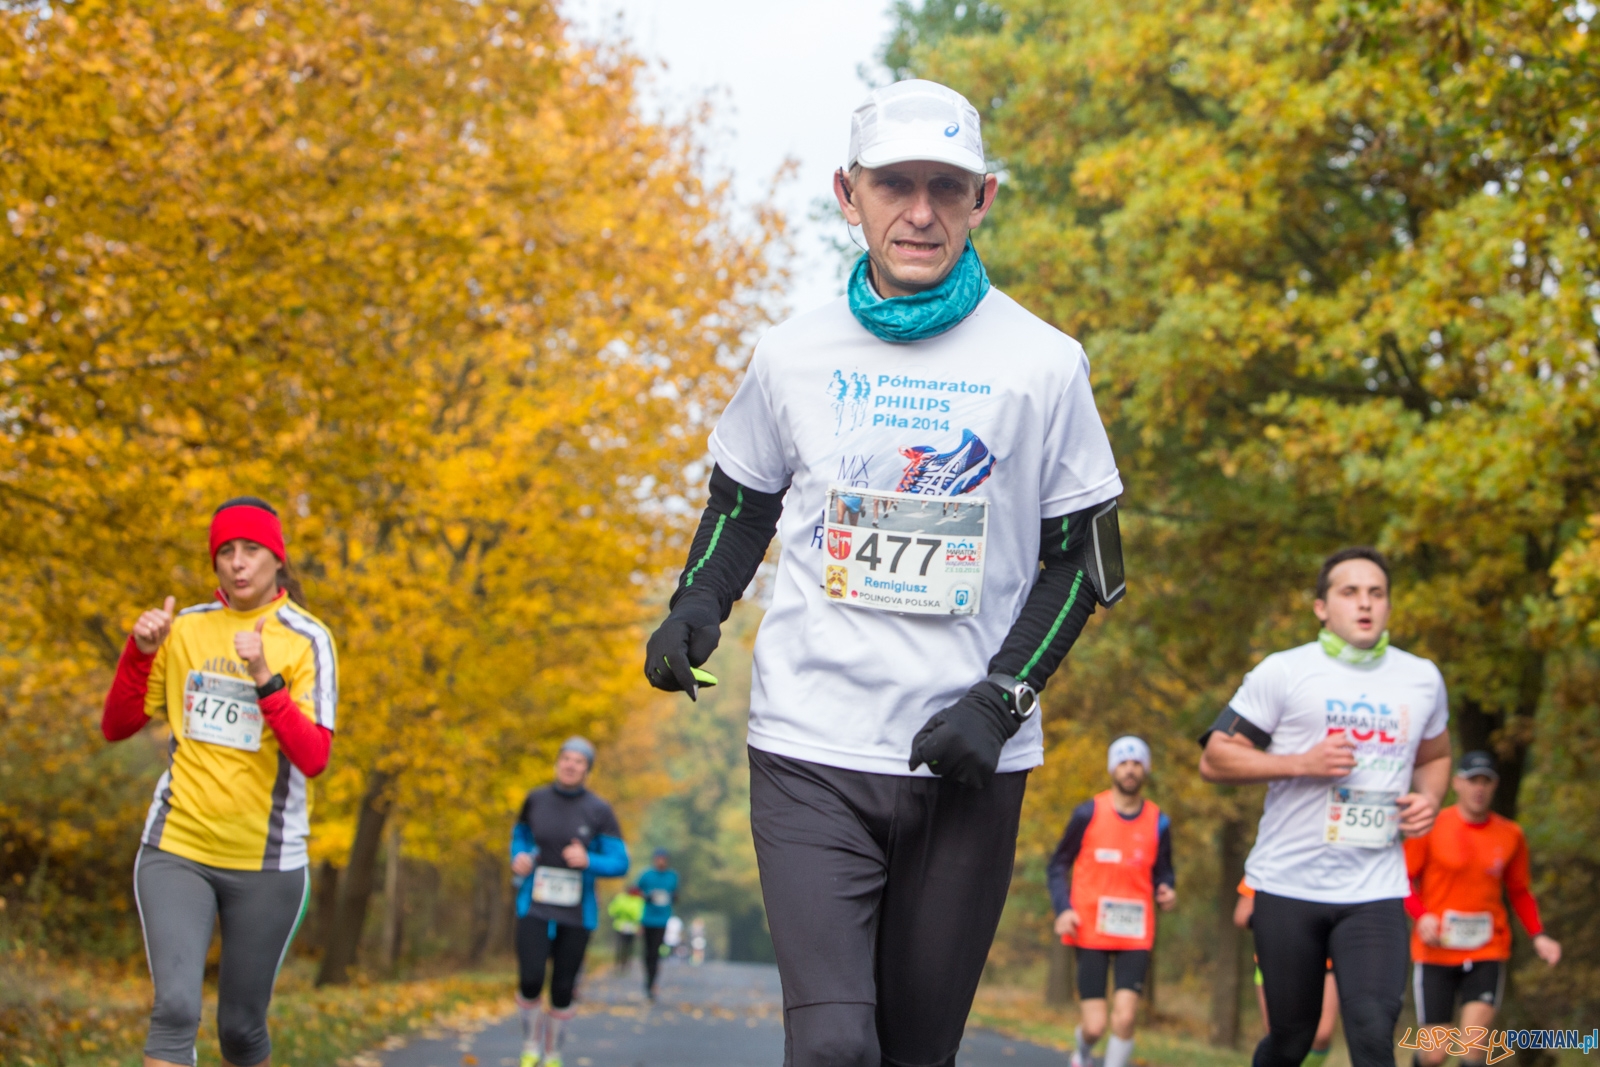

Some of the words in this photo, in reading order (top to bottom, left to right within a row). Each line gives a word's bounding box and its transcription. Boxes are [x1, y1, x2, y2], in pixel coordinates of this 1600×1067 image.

[877, 373, 991, 395] Półmaraton
[874, 395, 951, 413] PHILIPS
[872, 413, 908, 428] Piła
[911, 416, 950, 432] 2014
[837, 454, 875, 480] MIX
[855, 532, 942, 577] 477
[864, 576, 928, 594] Remigiusz
[859, 591, 903, 605] POLINOVA
[905, 598, 941, 608] POLSKA
[194, 696, 240, 725] 476
[1326, 714, 1399, 730] MARATON
[1345, 807, 1386, 828] 550
